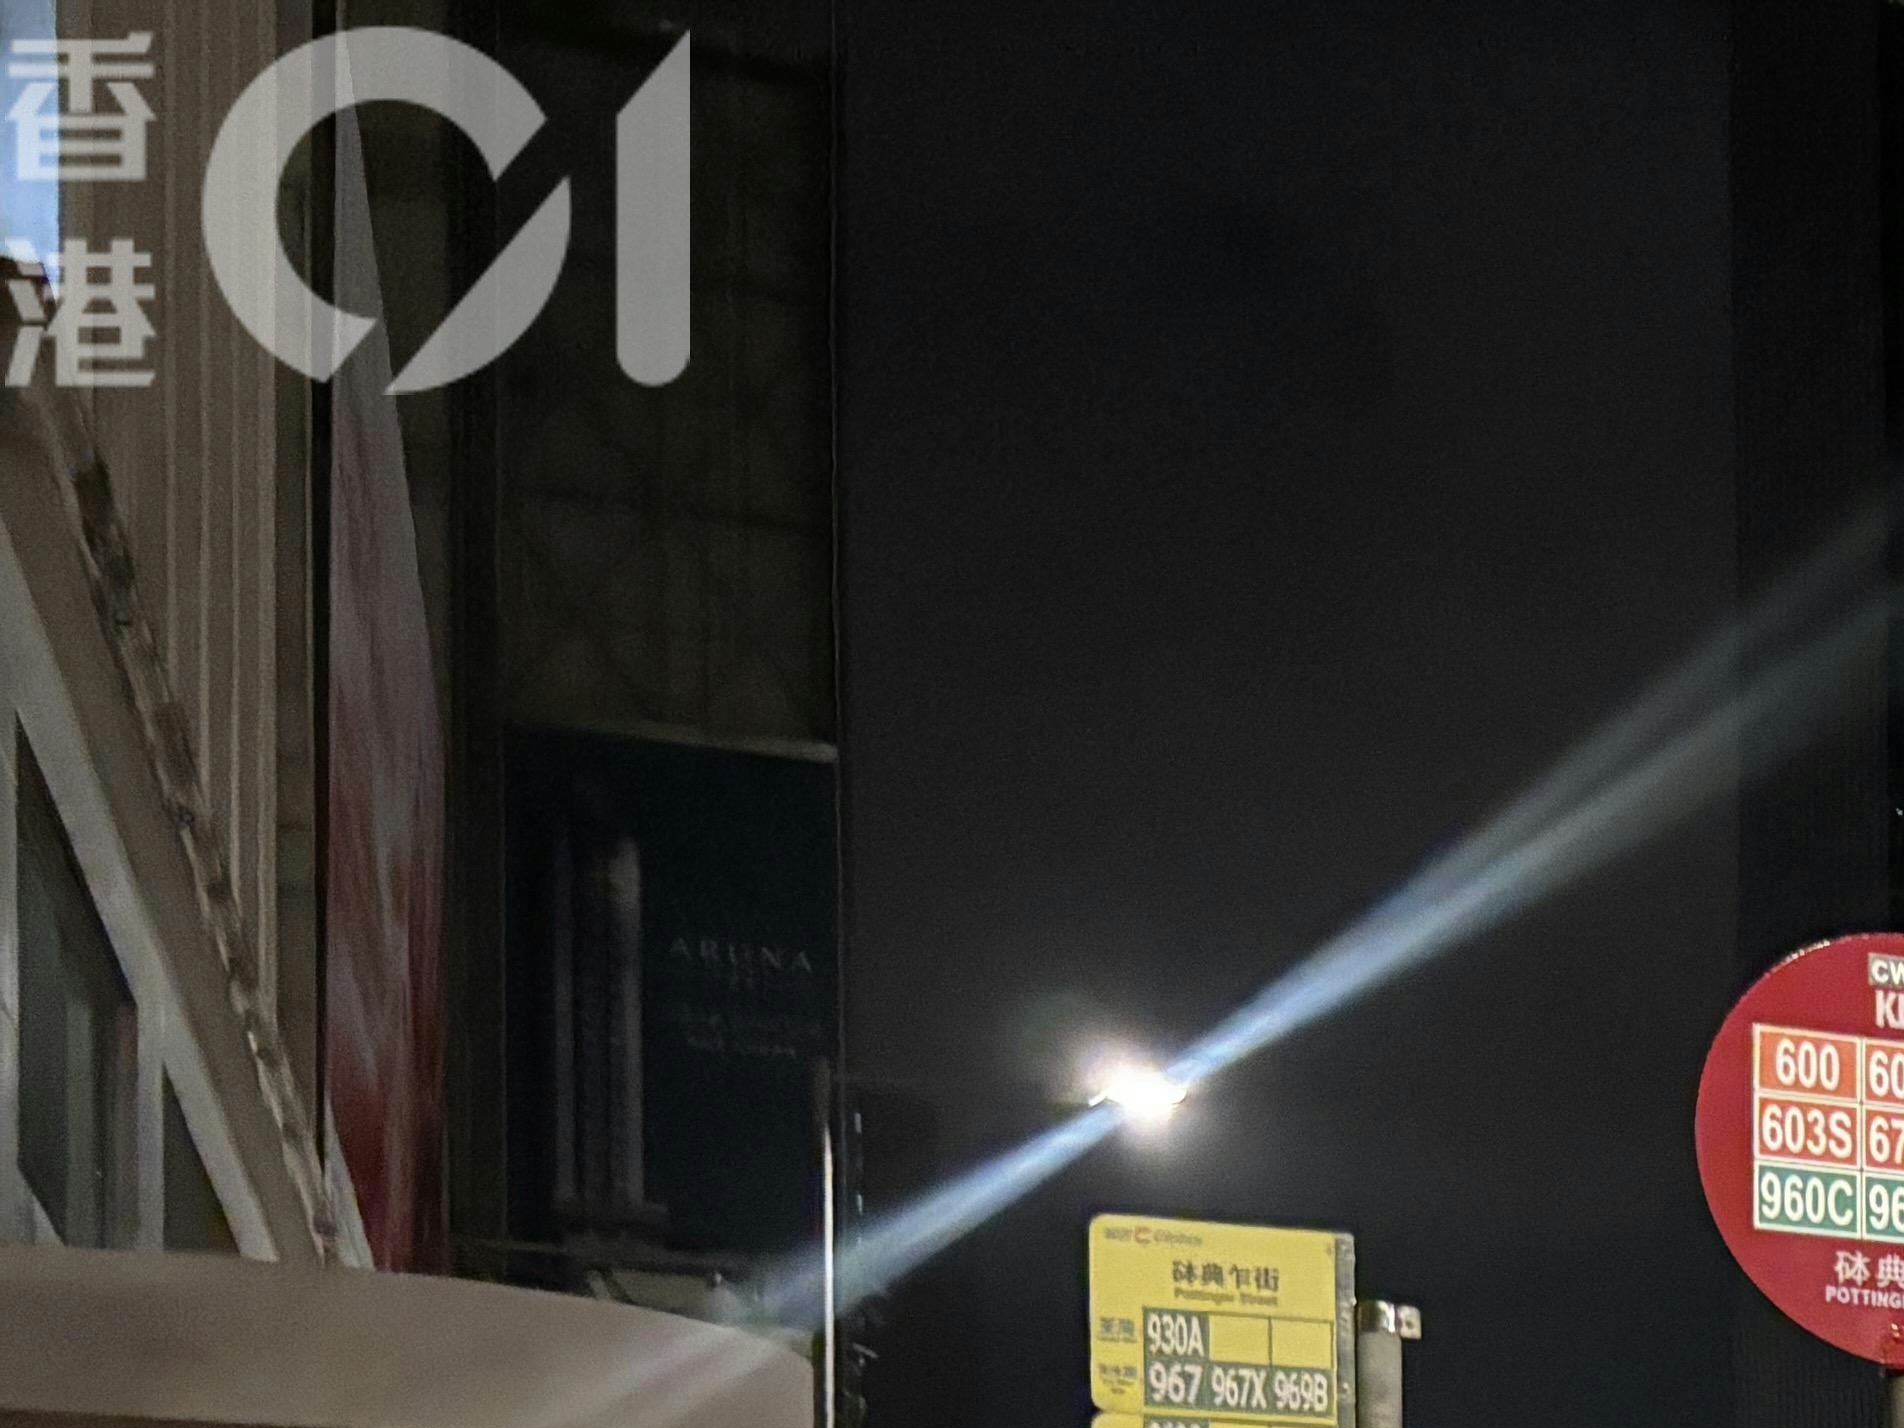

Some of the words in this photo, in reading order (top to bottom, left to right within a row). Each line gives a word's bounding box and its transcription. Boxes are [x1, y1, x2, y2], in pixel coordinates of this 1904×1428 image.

[1775, 1038, 1840, 1091] 600
[1762, 1102, 1852, 1159] 603S
[1760, 1171, 1853, 1226] 960C
[1147, 1312, 1204, 1357] 930A
[1149, 1362, 1201, 1406] 967
[1210, 1368, 1268, 1411] 967X
[1273, 1370, 1329, 1413] 969B
